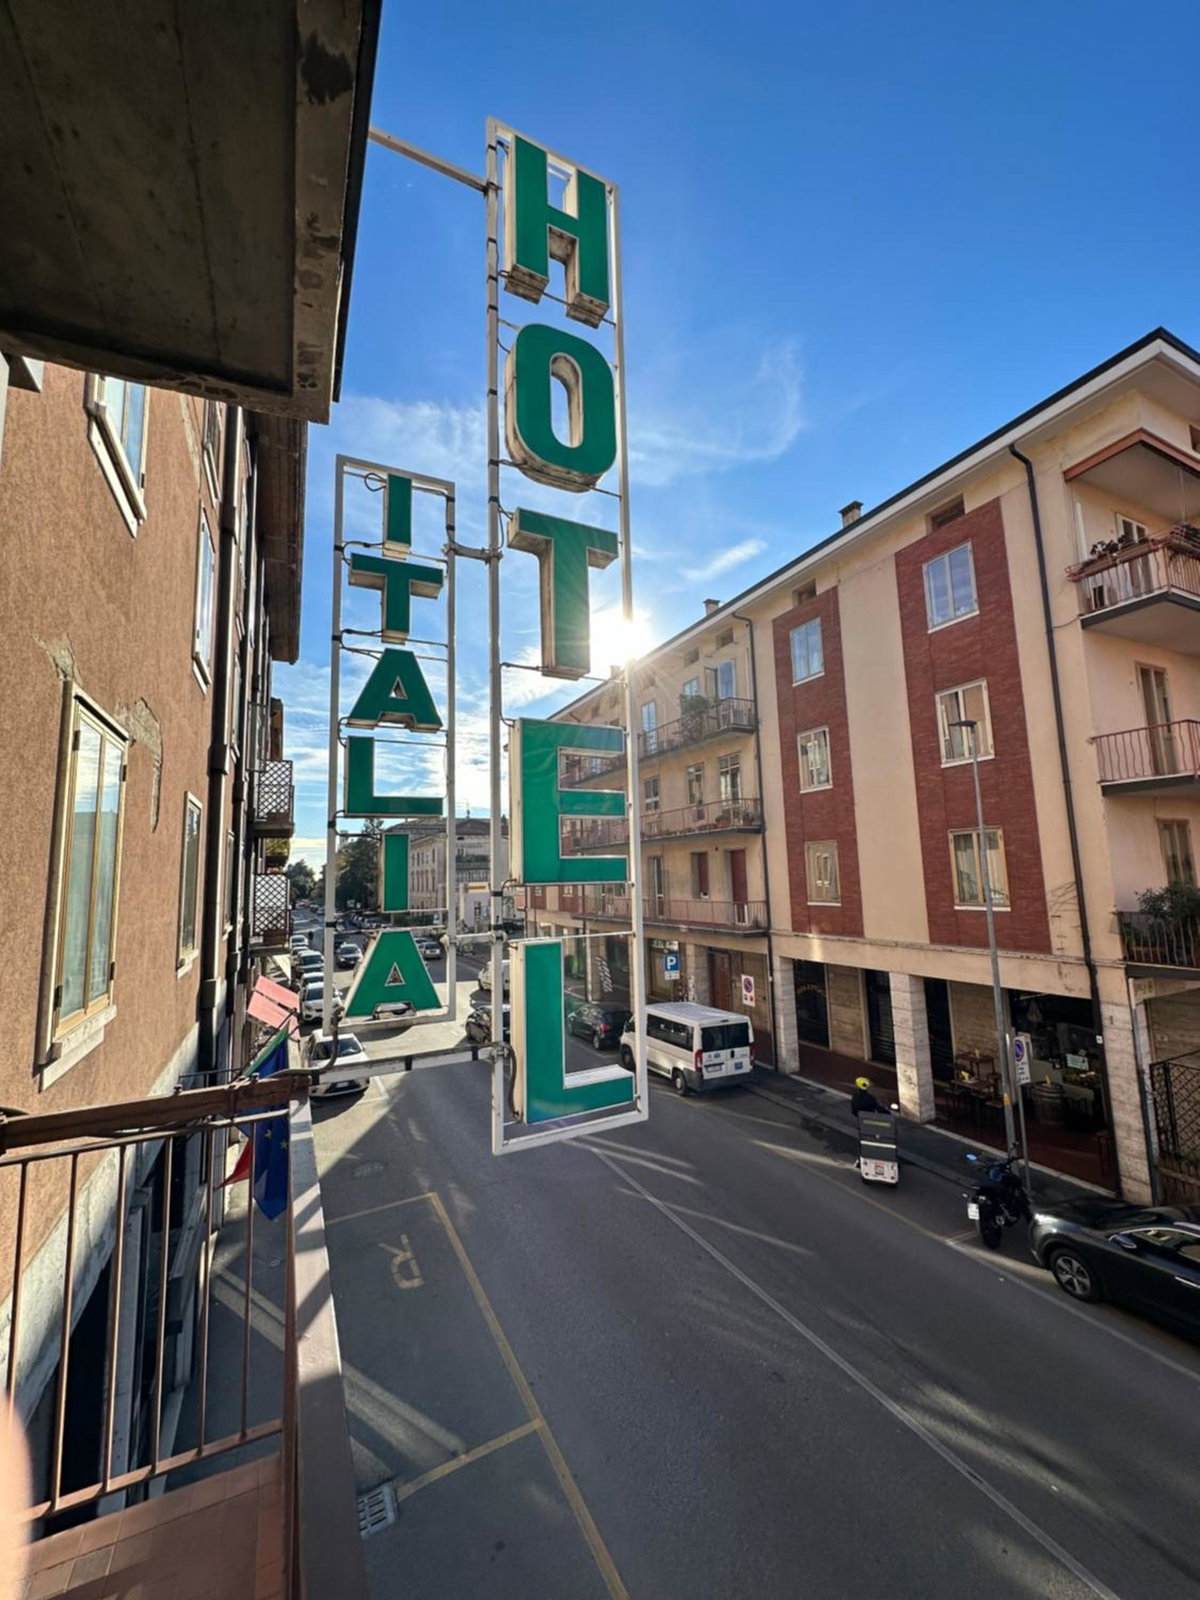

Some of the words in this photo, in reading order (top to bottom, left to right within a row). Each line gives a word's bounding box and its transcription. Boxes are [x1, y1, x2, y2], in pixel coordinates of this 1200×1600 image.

[345, 473, 443, 1018] ITALIA
[504, 133, 635, 1125] HOTEL
[666, 956, 677, 970] P
